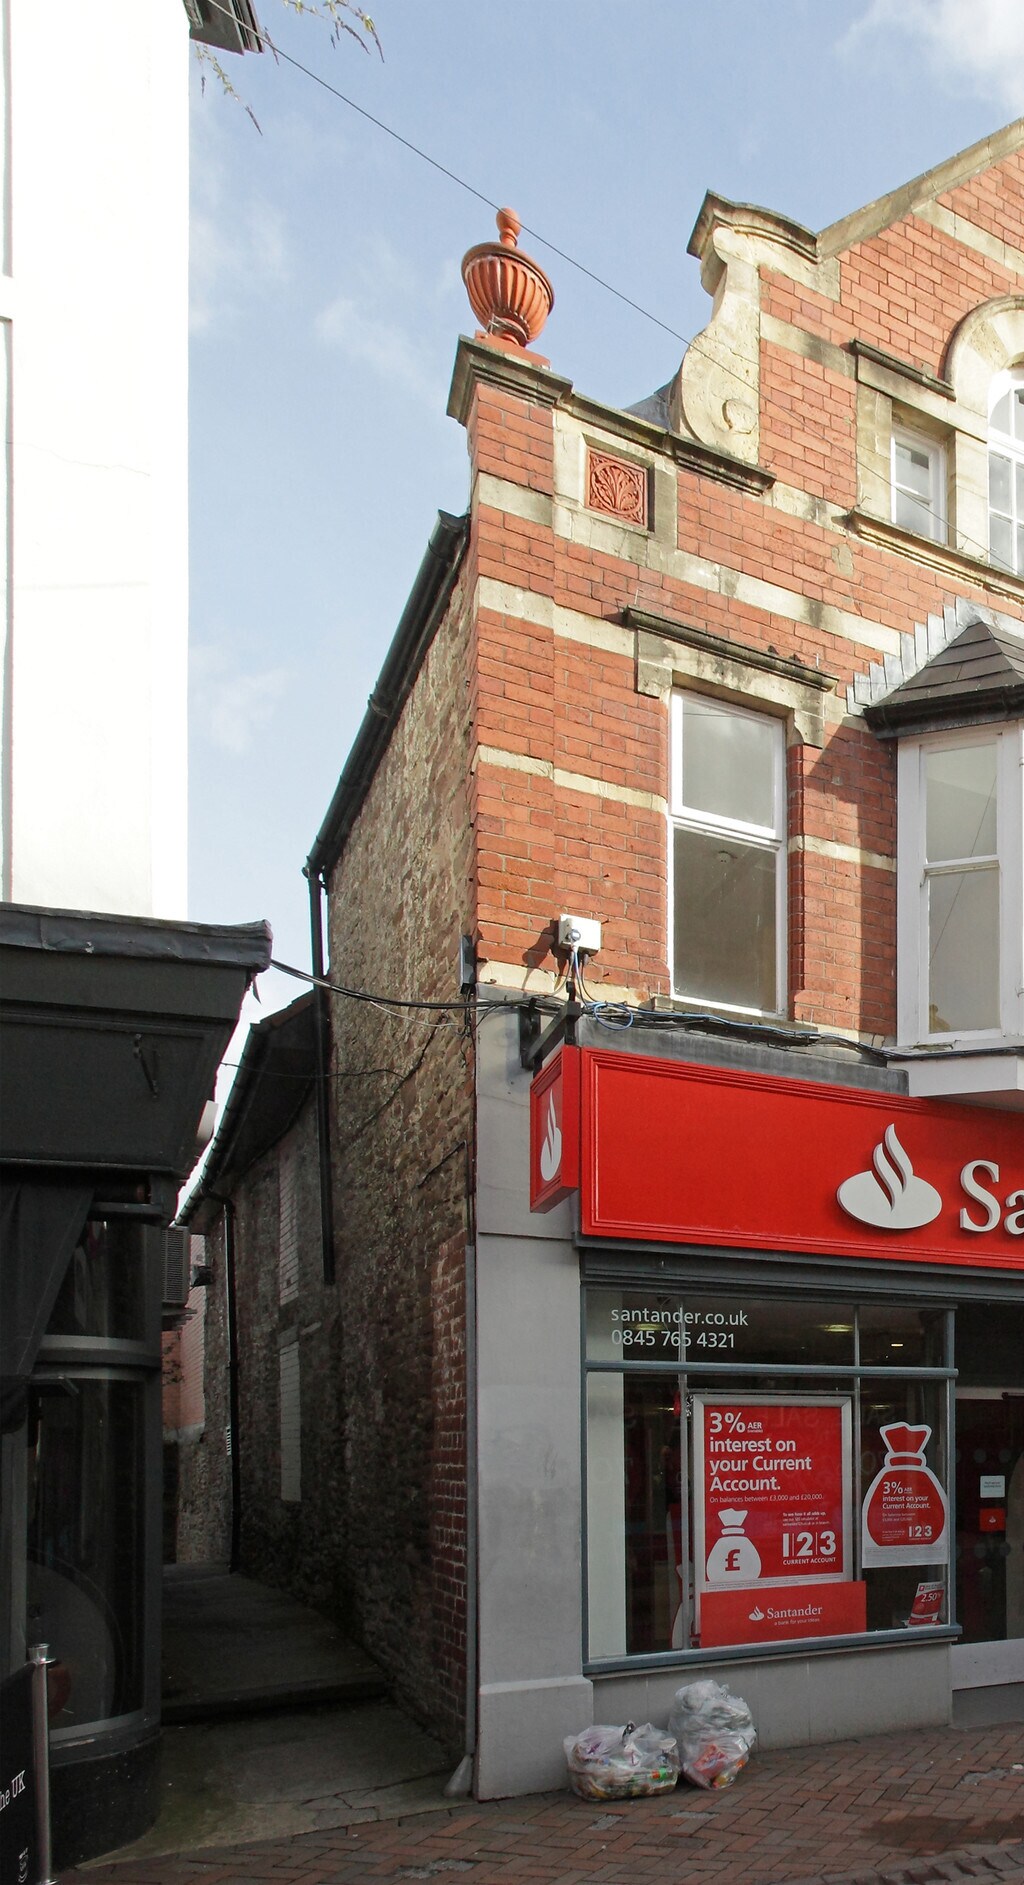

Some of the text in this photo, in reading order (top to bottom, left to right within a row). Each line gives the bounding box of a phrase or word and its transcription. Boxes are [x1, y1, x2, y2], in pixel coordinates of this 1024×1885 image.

[611, 1307, 749, 1327] santander.co.uk
[611, 1329, 735, 1348] 0845 765 4321
[709, 1412, 746, 1433] 3%
[709, 1437, 796, 1452] interest on
[709, 1456, 812, 1476] your Current
[709, 1476, 781, 1492] Account.
[882, 1481, 904, 1494] 3%
[725, 1549, 740, 1571] £
[783, 1558, 809, 1566] CURRENT
[767, 1604, 822, 1619] Santander
[11, 1770, 26, 1798] UK
